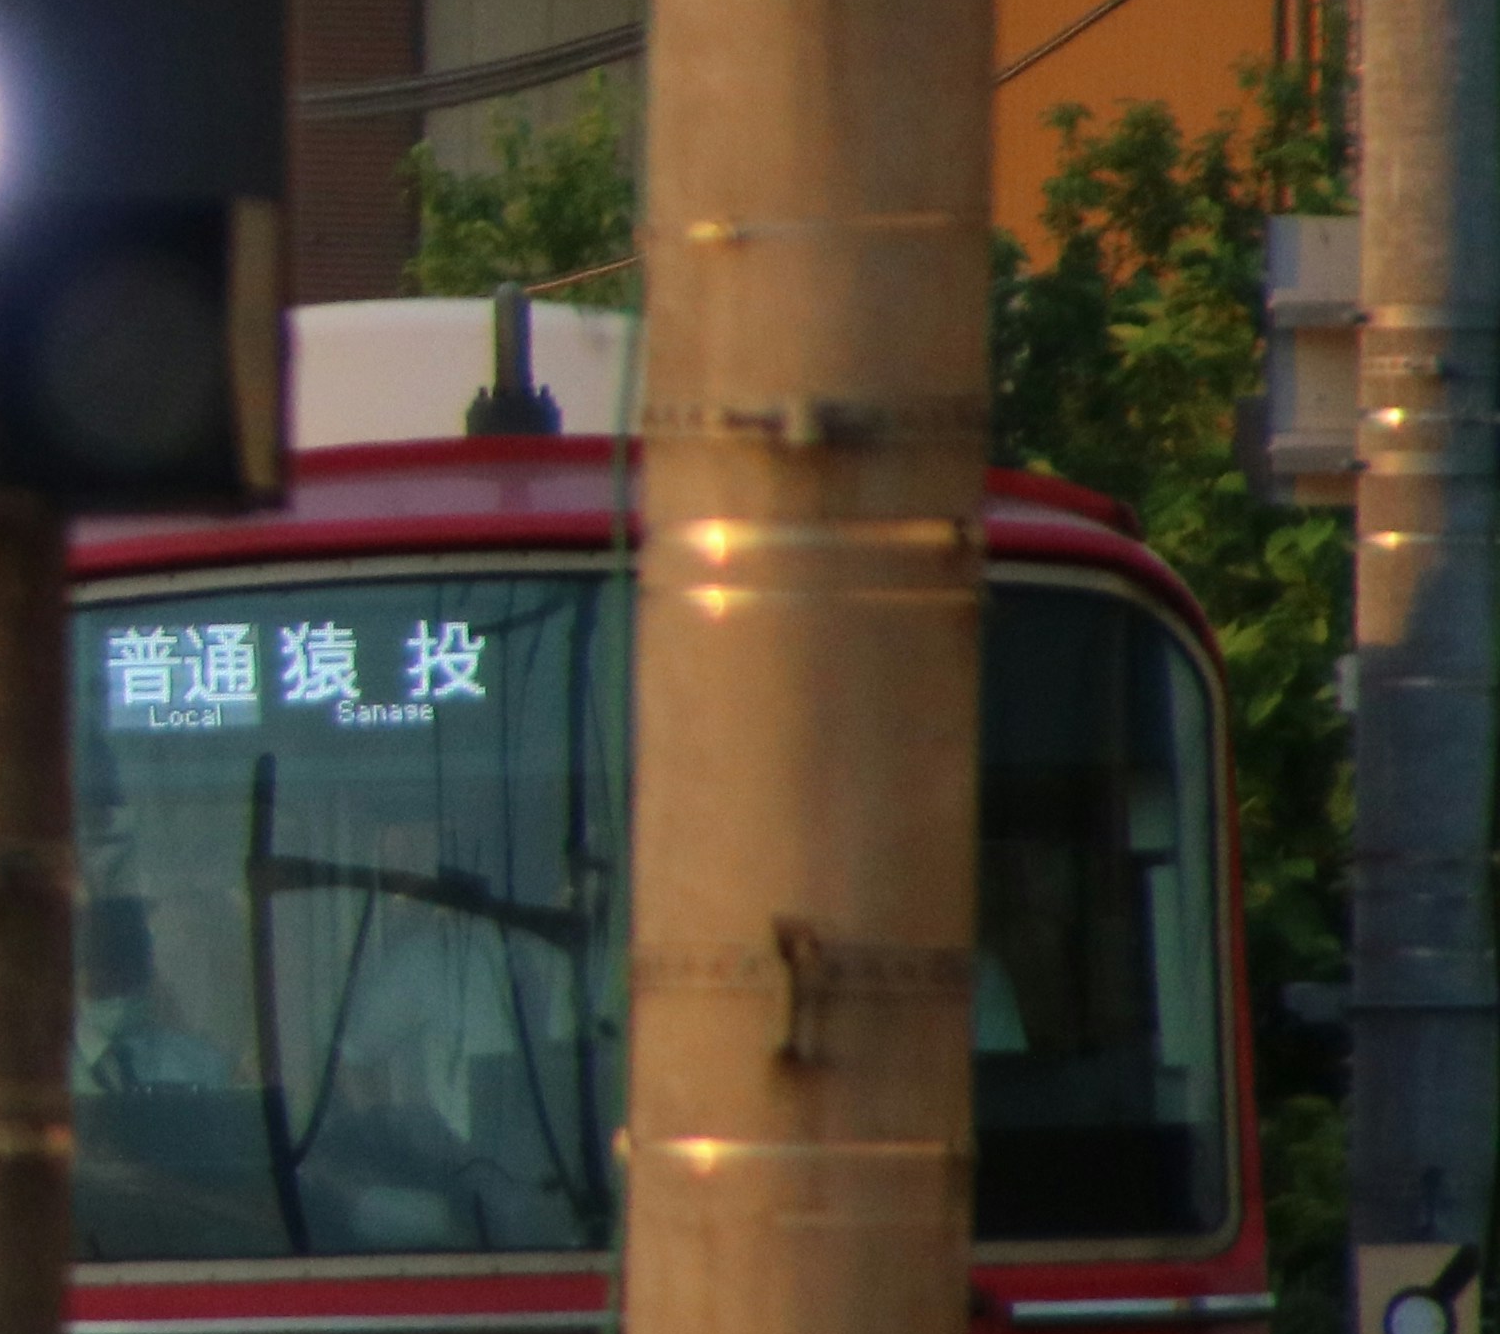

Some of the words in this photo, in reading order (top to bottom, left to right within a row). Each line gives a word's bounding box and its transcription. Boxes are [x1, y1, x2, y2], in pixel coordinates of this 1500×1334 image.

[108, 623, 257, 704] 普通
[280, 621, 485, 701] 猿投
[149, 704, 222, 727] Local
[336, 701, 435, 724] Sanage
